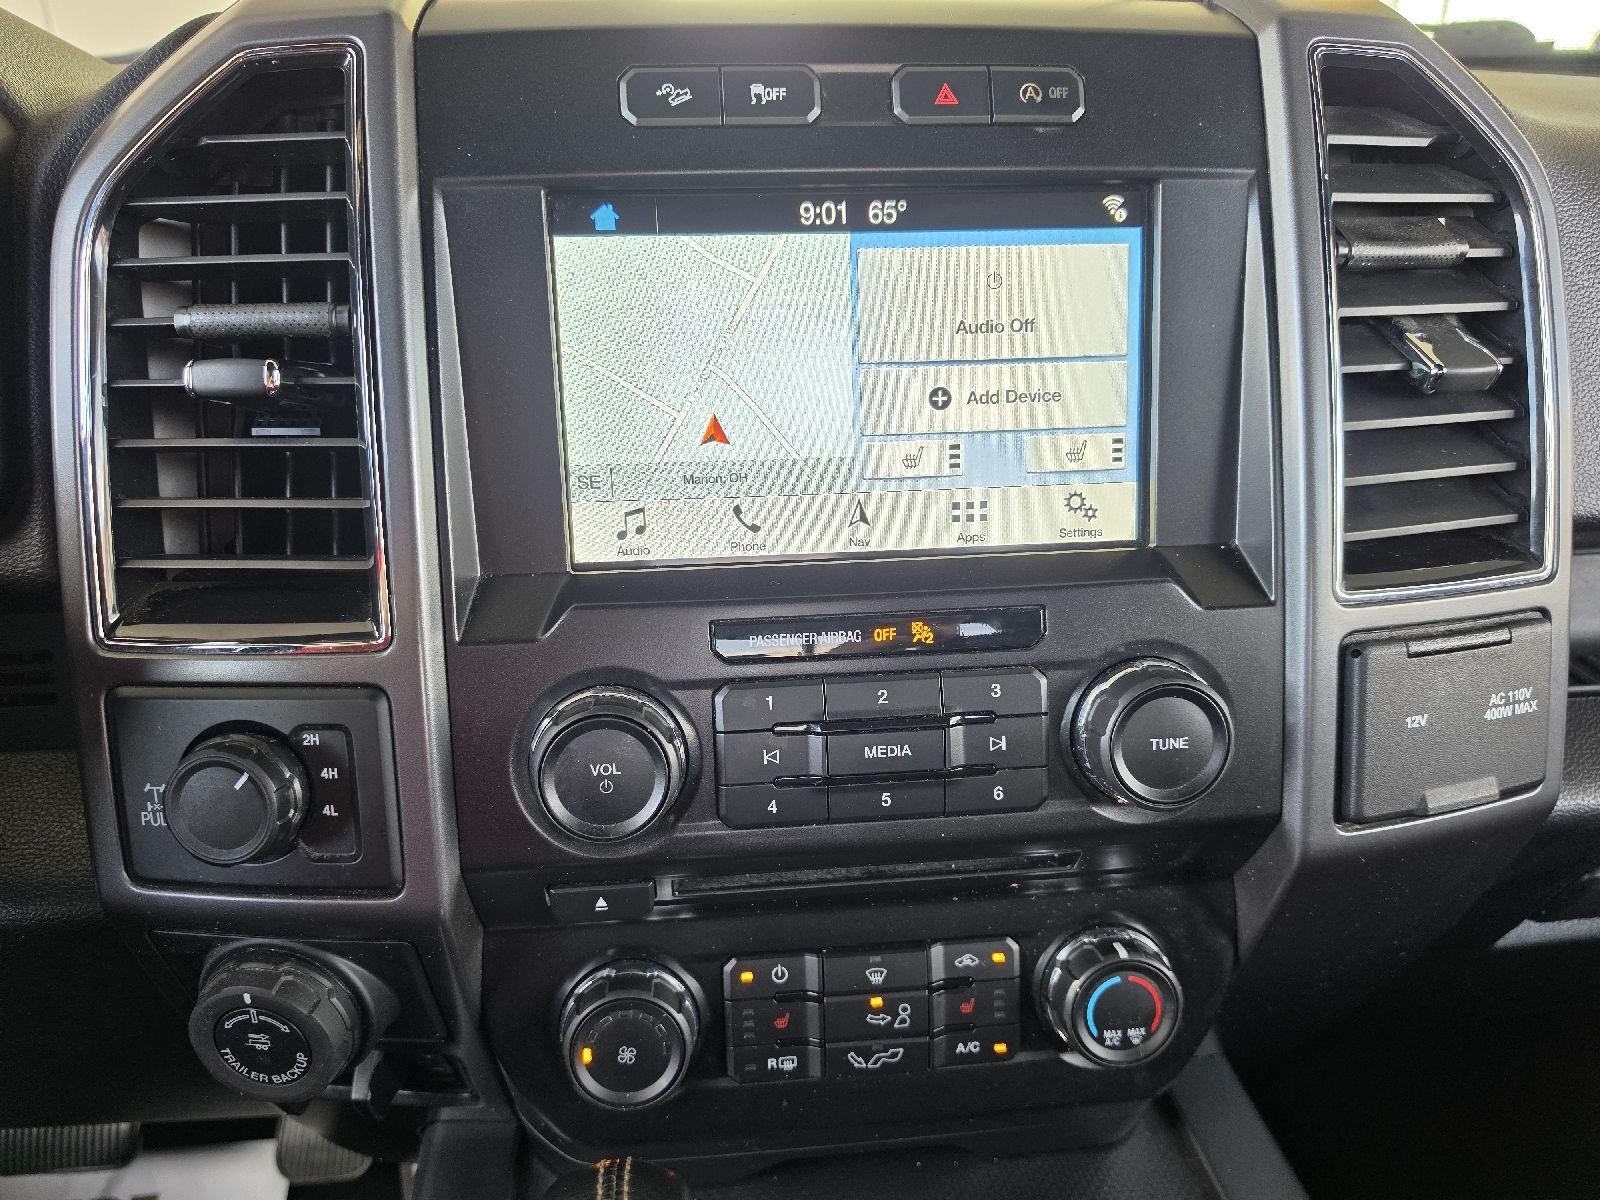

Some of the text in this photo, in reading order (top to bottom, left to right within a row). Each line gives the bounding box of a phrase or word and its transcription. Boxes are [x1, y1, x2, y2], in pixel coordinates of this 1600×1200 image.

[765, 86, 787, 101] OFF
[1048, 86, 1069, 100] OFF
[799, 200, 908, 226] 9:01 65°
[955, 317, 1036, 335] Audio Off
[966, 387, 1062, 405] Add Device
[577, 475, 601, 490] SE
[729, 472, 748, 483] OH
[957, 532, 986, 545] Apps
[1059, 526, 1103, 540] Settings
[730, 541, 767, 553] Phone
[849, 536, 871, 548] Nav
[616, 545, 651, 557] Audio
[749, 627, 897, 648] PASSENGER AIRBAG OFF
[878, 689, 889, 704] 2
[990, 683, 1002, 699] 3
[1489, 686, 1533, 706] AC 110V
[765, 695, 774, 710] 1
[1483, 699, 1538, 721] 400W MAX
[1405, 714, 1429, 729] 12V
[302, 733, 320, 746] 2H
[1150, 736, 1189, 751] TUNE
[864, 744, 912, 759] MEDIA
[320, 767, 339, 780] 4H
[590, 763, 622, 777] VOL
[881, 792, 892, 807] 5
[993, 786, 1004, 801] 6
[322, 804, 339, 817] 4L
[767, 799, 778, 814] 4
[141, 811, 168, 827] PUL
[1103, 1029, 1122, 1039] MAX
[955, 1040, 981, 1054] A/C
[220, 1047, 309, 1084] TRAILER BACKUP
